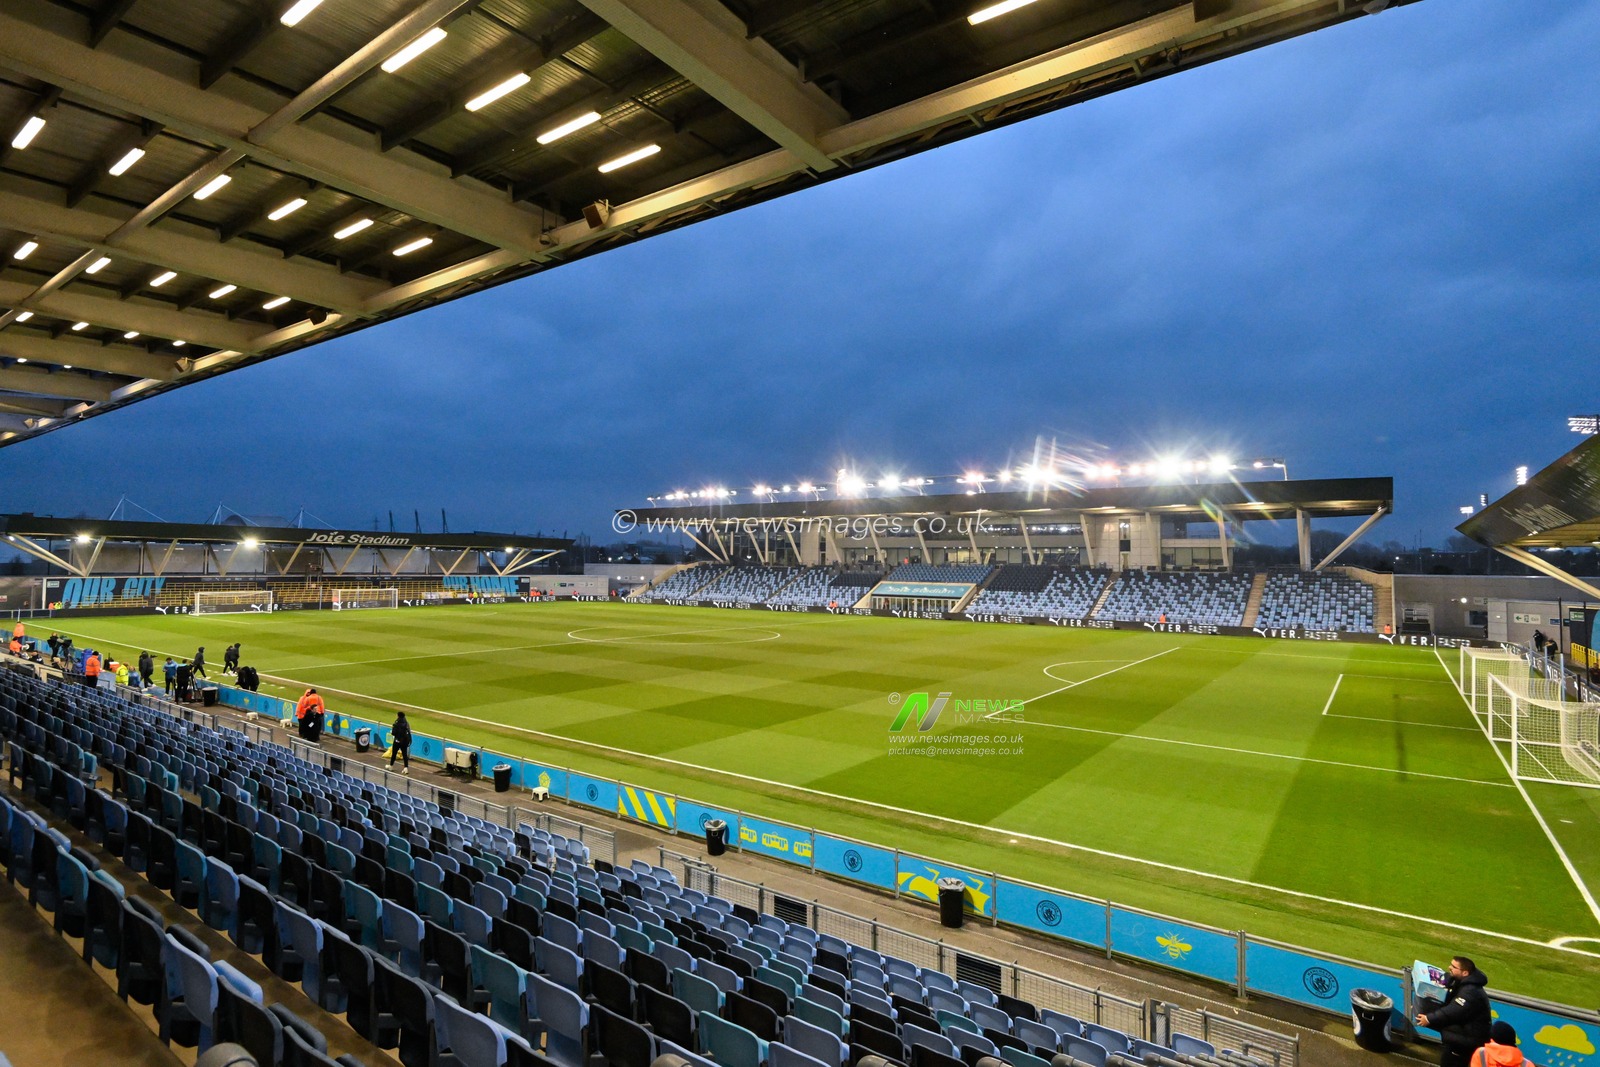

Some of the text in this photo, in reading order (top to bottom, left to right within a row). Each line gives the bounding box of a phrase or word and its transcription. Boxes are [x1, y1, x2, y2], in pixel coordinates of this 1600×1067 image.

[306, 531, 409, 545] Joie Stadium
[62, 577, 165, 608] OUR CITY
[1160, 623, 1186, 633] VER.
[1271, 629, 1301, 640] VER.
[1400, 636, 1433, 647] VER.
